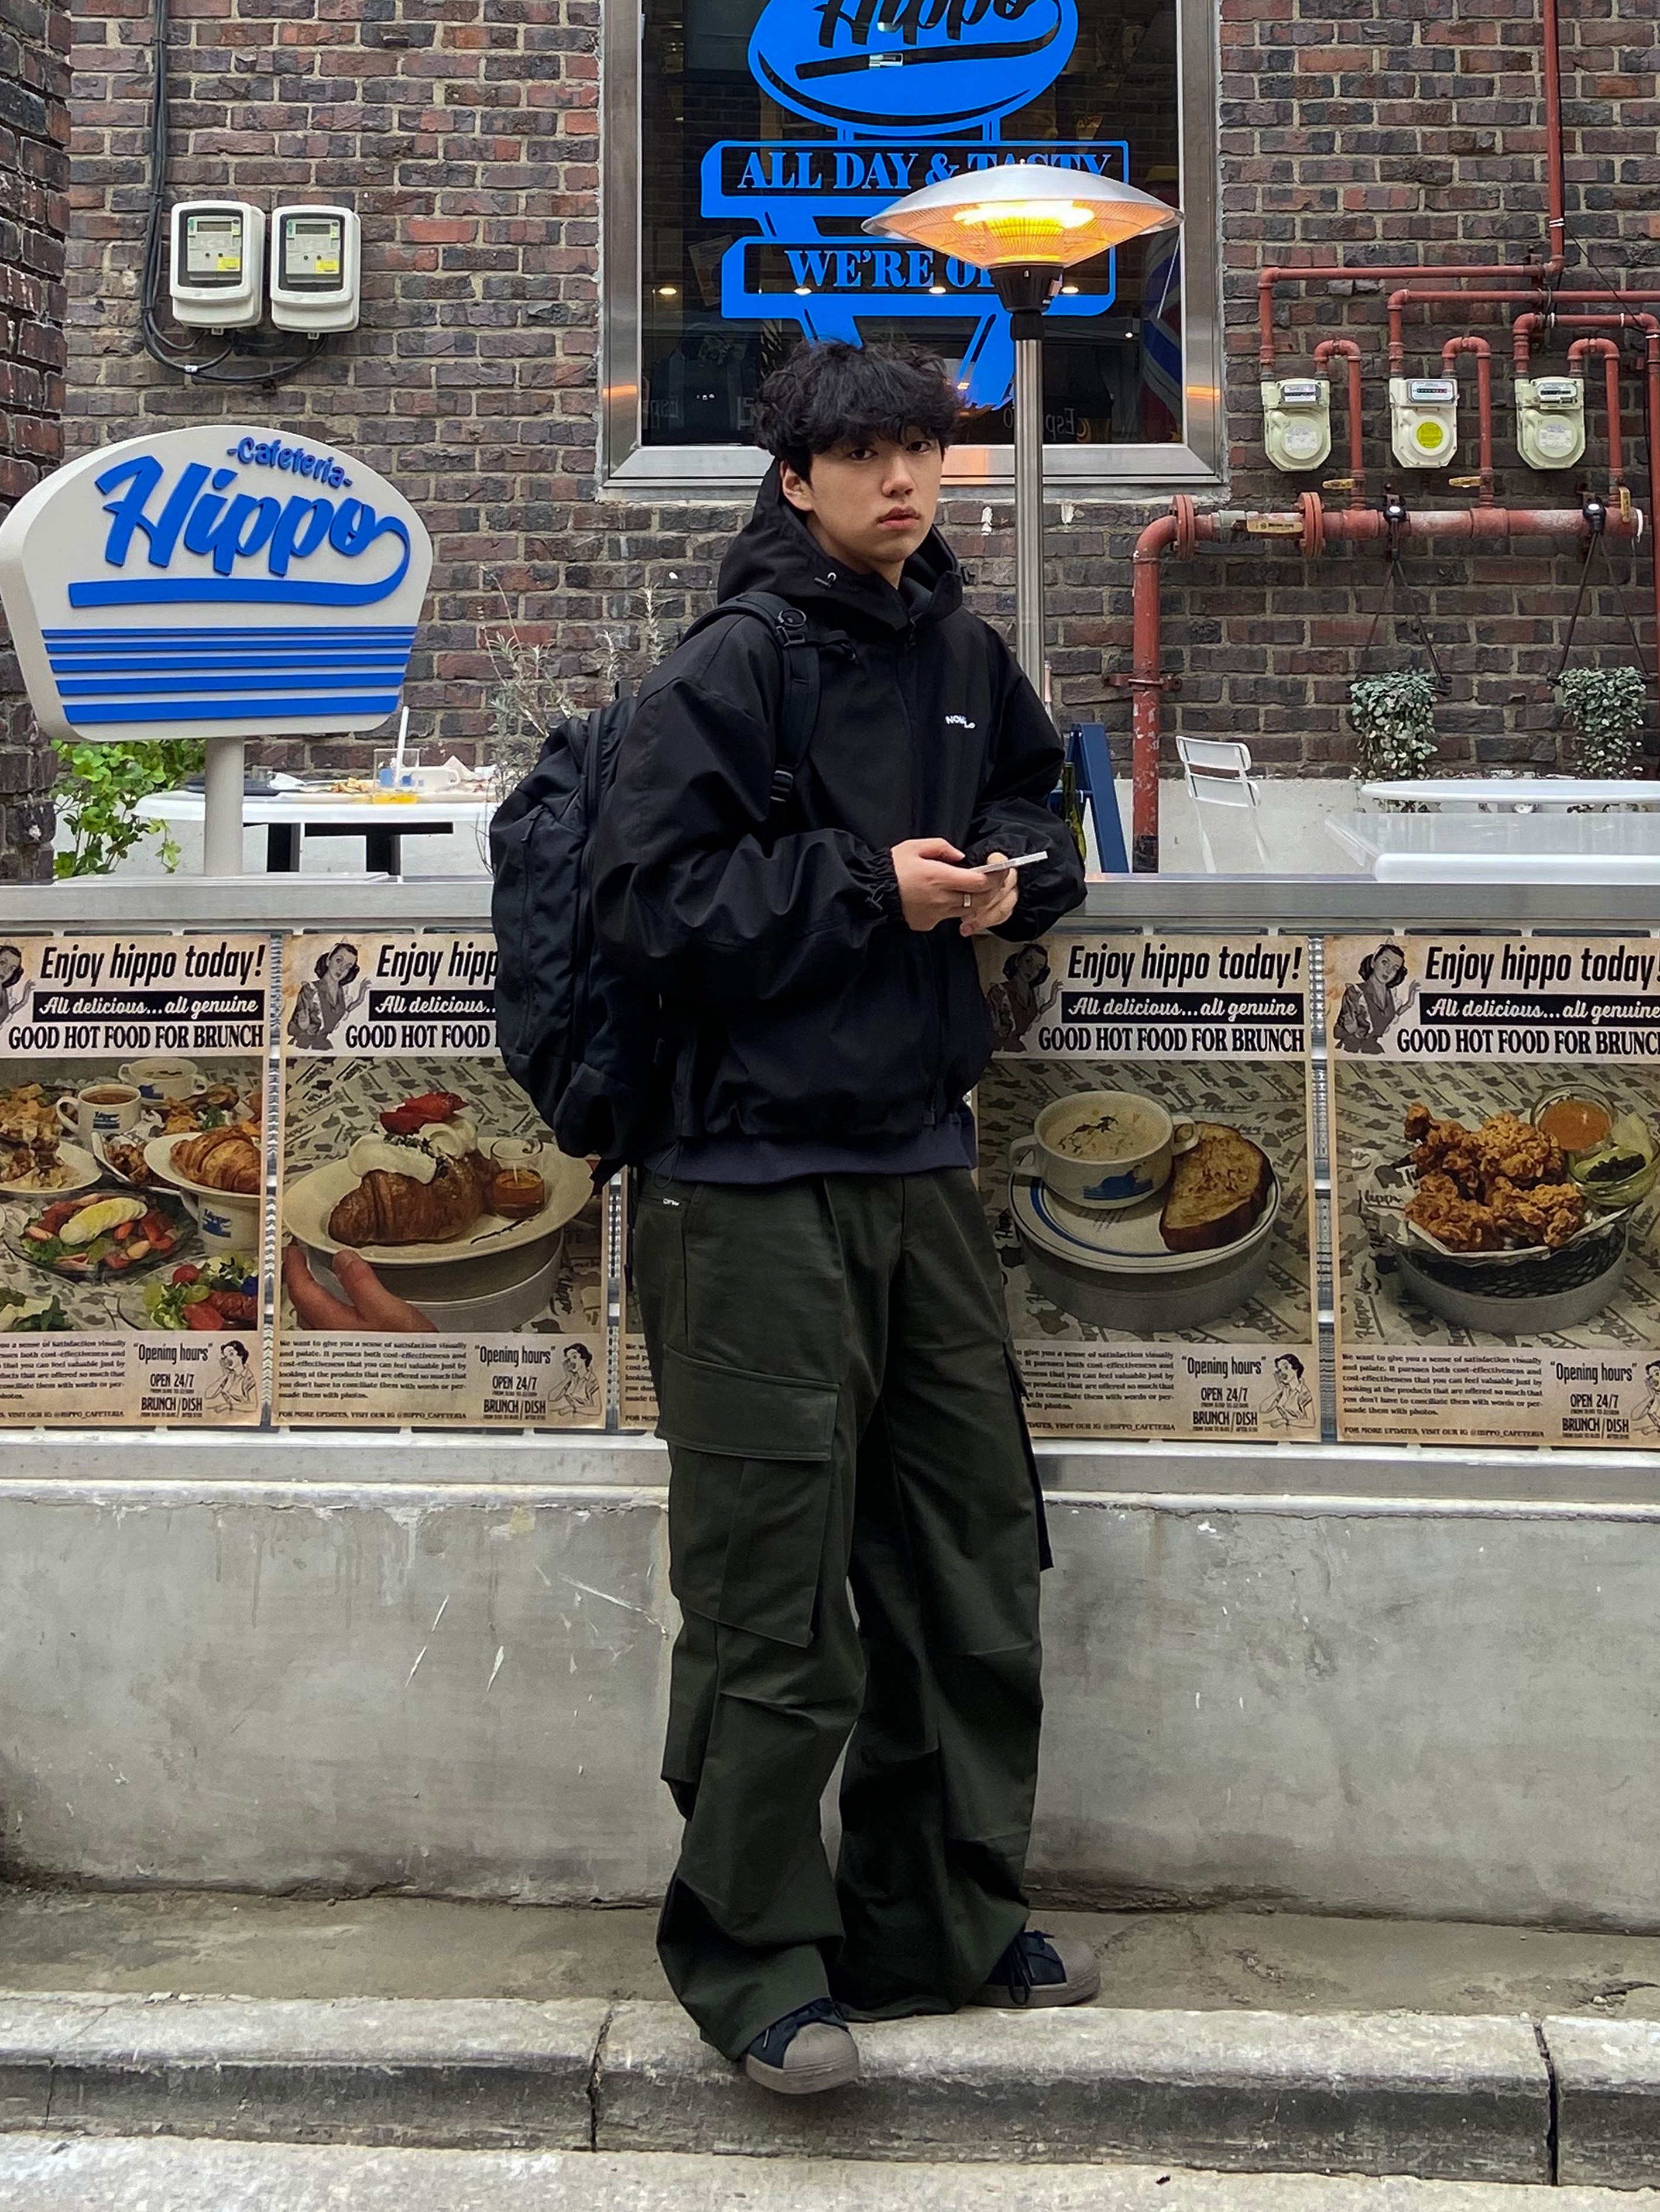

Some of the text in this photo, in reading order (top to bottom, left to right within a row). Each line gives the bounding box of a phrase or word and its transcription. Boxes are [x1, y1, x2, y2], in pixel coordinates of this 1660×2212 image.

[737, 153, 822, 190] ALL
[834, 153, 915, 190] DAY
[785, 250, 935, 287] WE'RE
[95, 455, 411, 577] Hippo
[40, 942, 265, 987] Enjoy hippo today!
[376, 941, 499, 985] Enjoy hipp
[1068, 943, 1302, 988] Enjoy hippo today!
[1425, 944, 1494, 988] Enjoy
[1501, 944, 1571, 990] hippo
[39, 997, 70, 1014] All
[191, 996, 258, 1019] genuine
[375, 995, 406, 1013] All
[1068, 997, 1100, 1015] All
[1228, 999, 1297, 1022] genuine
[1426, 998, 1459, 1016] All
[1591, 1001, 1660, 1024] genuine
[9, 1025, 264, 1049] GOOD HOT FOOD FOR BRUNCH
[346, 1025, 491, 1048] GOOD HOT FOOD
[1038, 1027, 1305, 1052] GOOD HOT FOOD FOR BRUNCH
[1397, 1029, 1660, 1055] GOOD HOT FOOD FOR BRUNC
[150, 1373, 194, 1387] OPEN 24/7
[492, 1376, 537, 1391] OPEN 24/7
[142, 1397, 202, 1411] BRUNCH DISH
[484, 1399, 546, 1414] BRUNCH DISH
[1201, 1387, 1247, 1402] OPEN 24/7
[1570, 1394, 1618, 1409] OPEN 24/7
[1193, 1411, 1257, 1425] BRUNCH DISH
[1562, 1418, 1628, 1433] BRUNCH DISH
